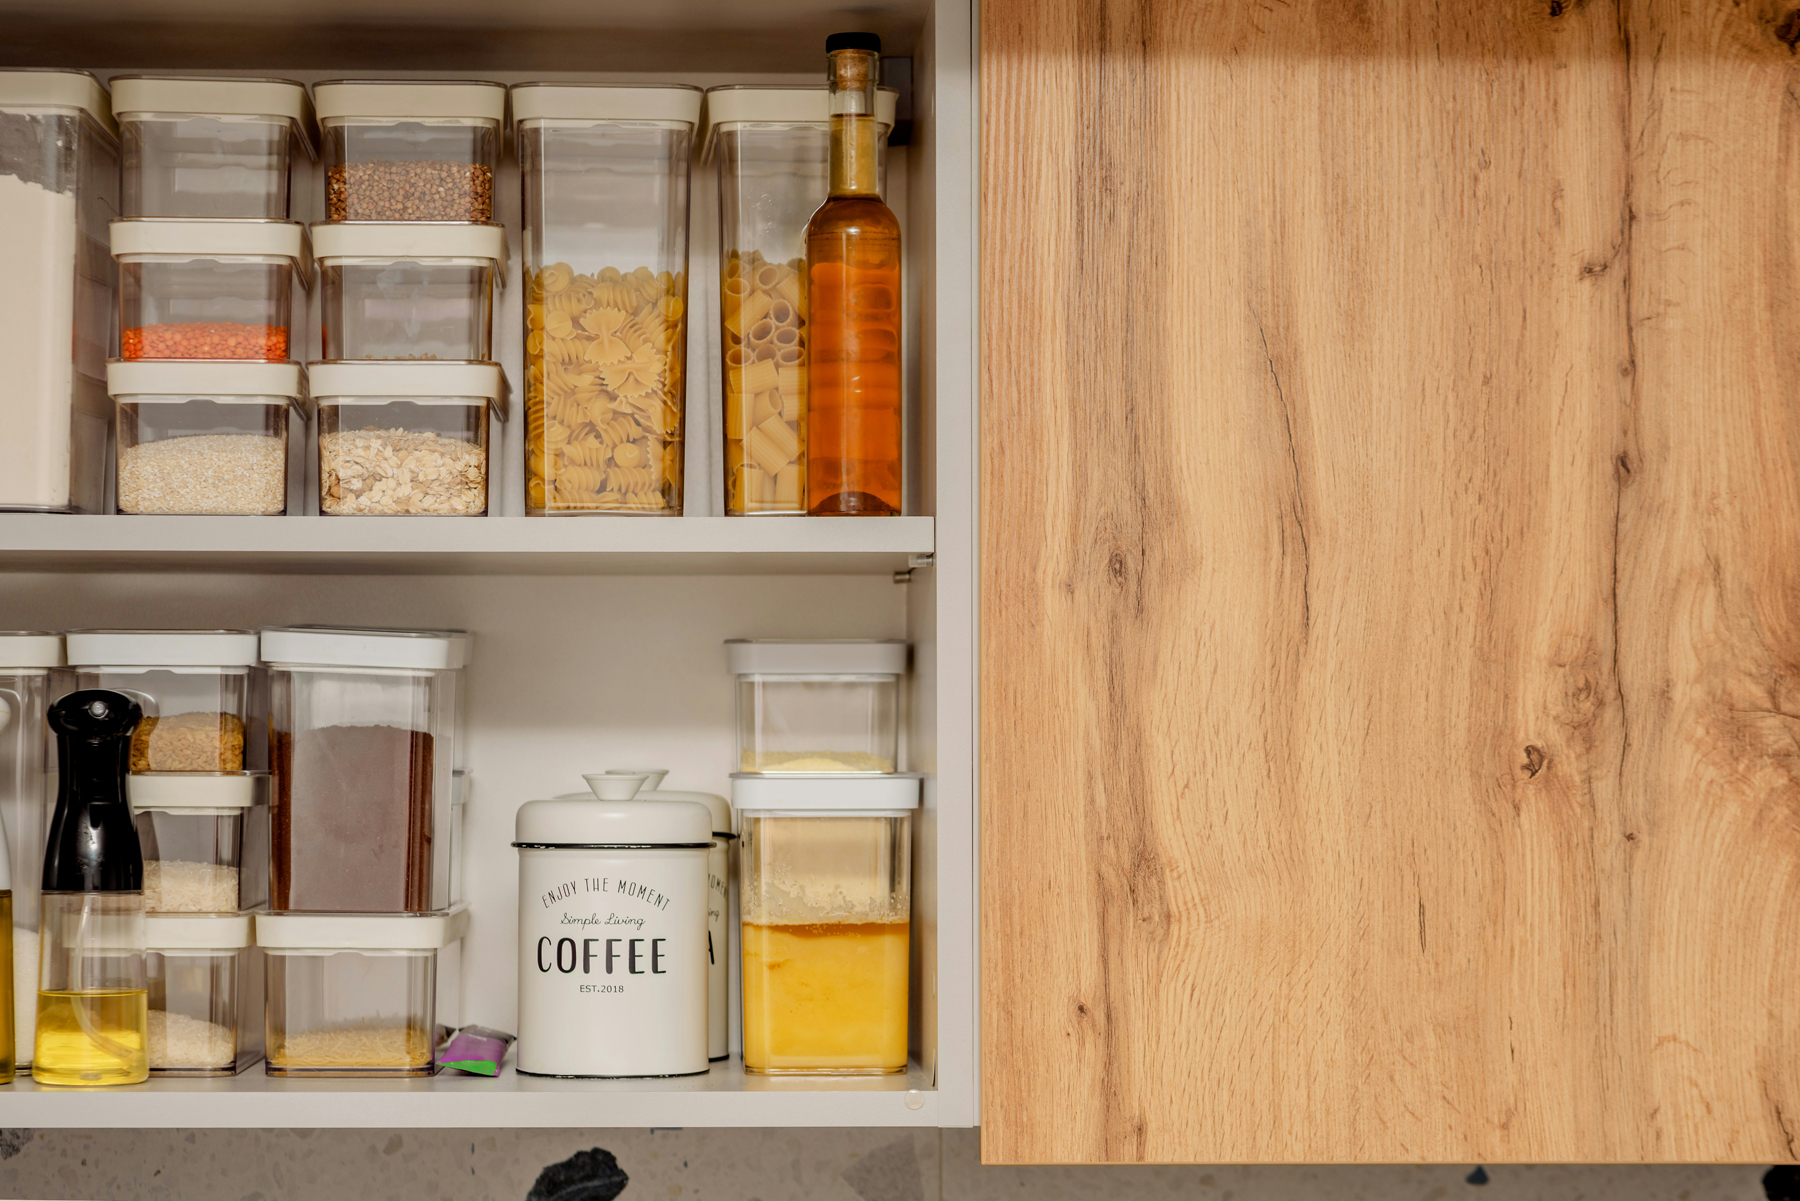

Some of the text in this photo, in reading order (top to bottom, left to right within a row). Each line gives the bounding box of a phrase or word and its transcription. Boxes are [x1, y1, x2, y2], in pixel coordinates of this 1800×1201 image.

[541, 878, 671, 911] ENJOY THE MOMENT
[560, 912, 646, 930] Simple Living
[537, 936, 667, 974] COFFEE
[579, 984, 625, 993] EST.2018
